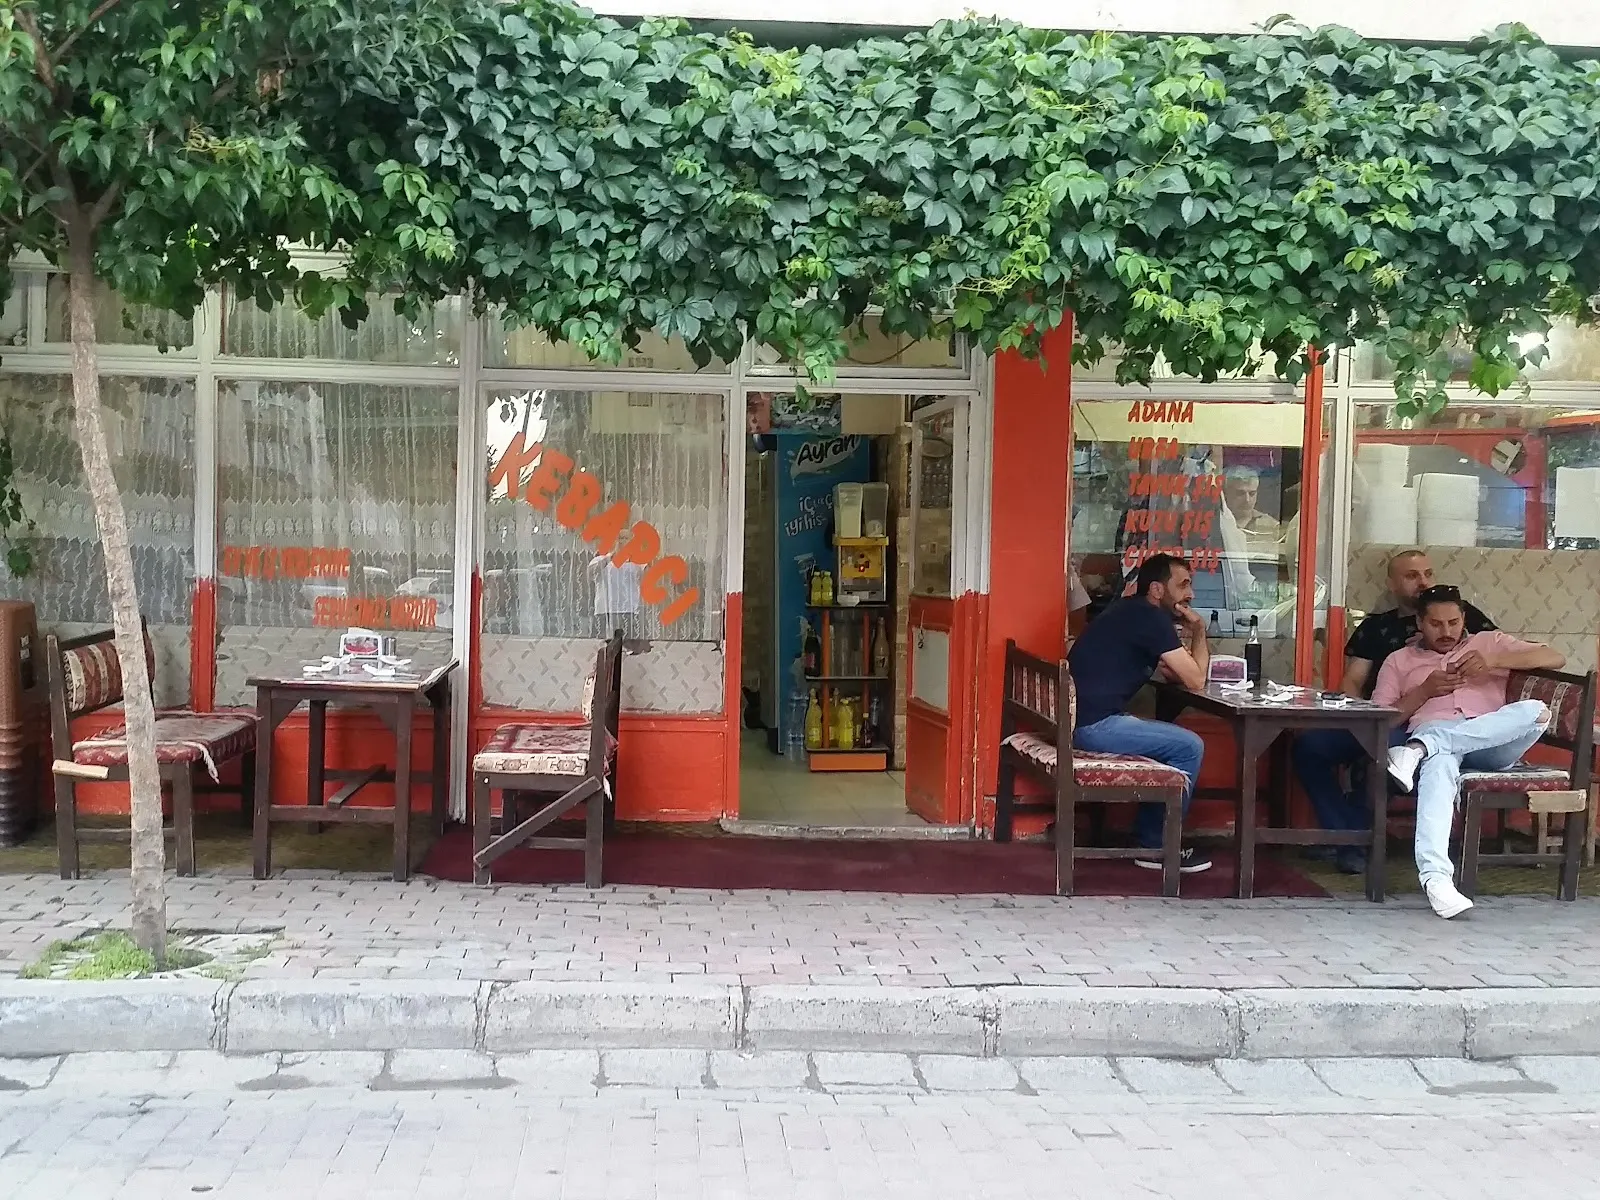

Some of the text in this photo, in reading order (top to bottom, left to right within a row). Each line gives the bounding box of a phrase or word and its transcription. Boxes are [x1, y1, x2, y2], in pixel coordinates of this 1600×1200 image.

[1128, 401, 1194, 423] ADANA
[797, 434, 856, 467] Ayran
[1127, 436, 1178, 460] URFA
[1128, 474, 1188, 496] TAVUK
[488, 432, 699, 627] KEBAPCI
[1124, 509, 1178, 533] KUZU
